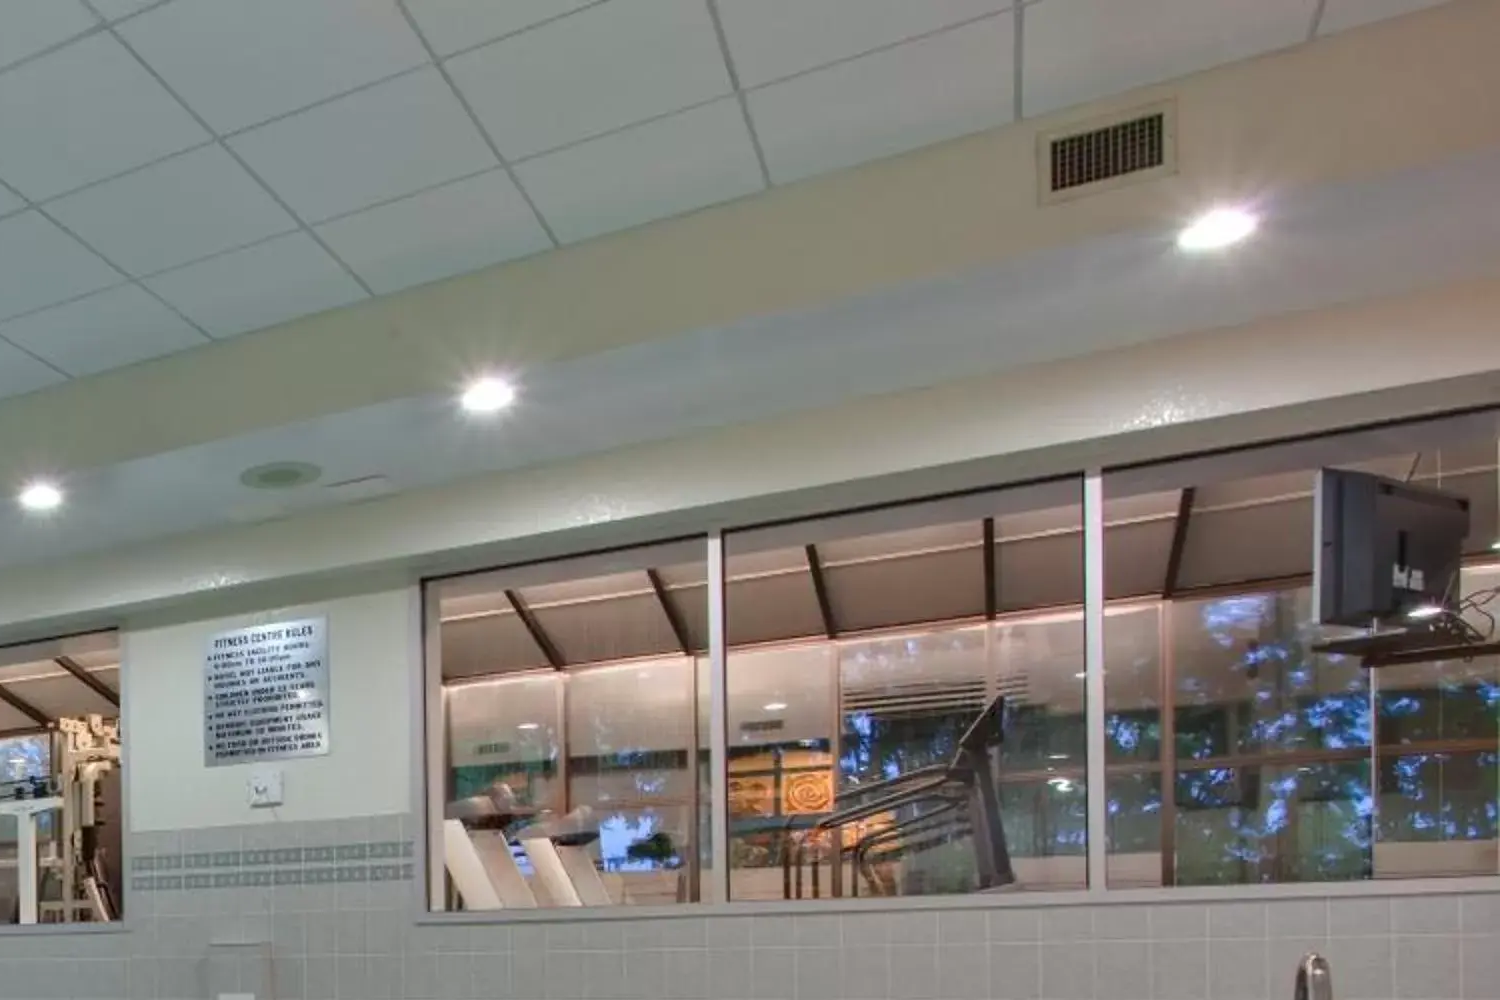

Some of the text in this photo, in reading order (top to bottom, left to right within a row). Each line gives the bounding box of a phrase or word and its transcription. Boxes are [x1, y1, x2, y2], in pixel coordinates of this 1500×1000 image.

[214, 626, 312, 648] FITNESS CENTRE RULES
